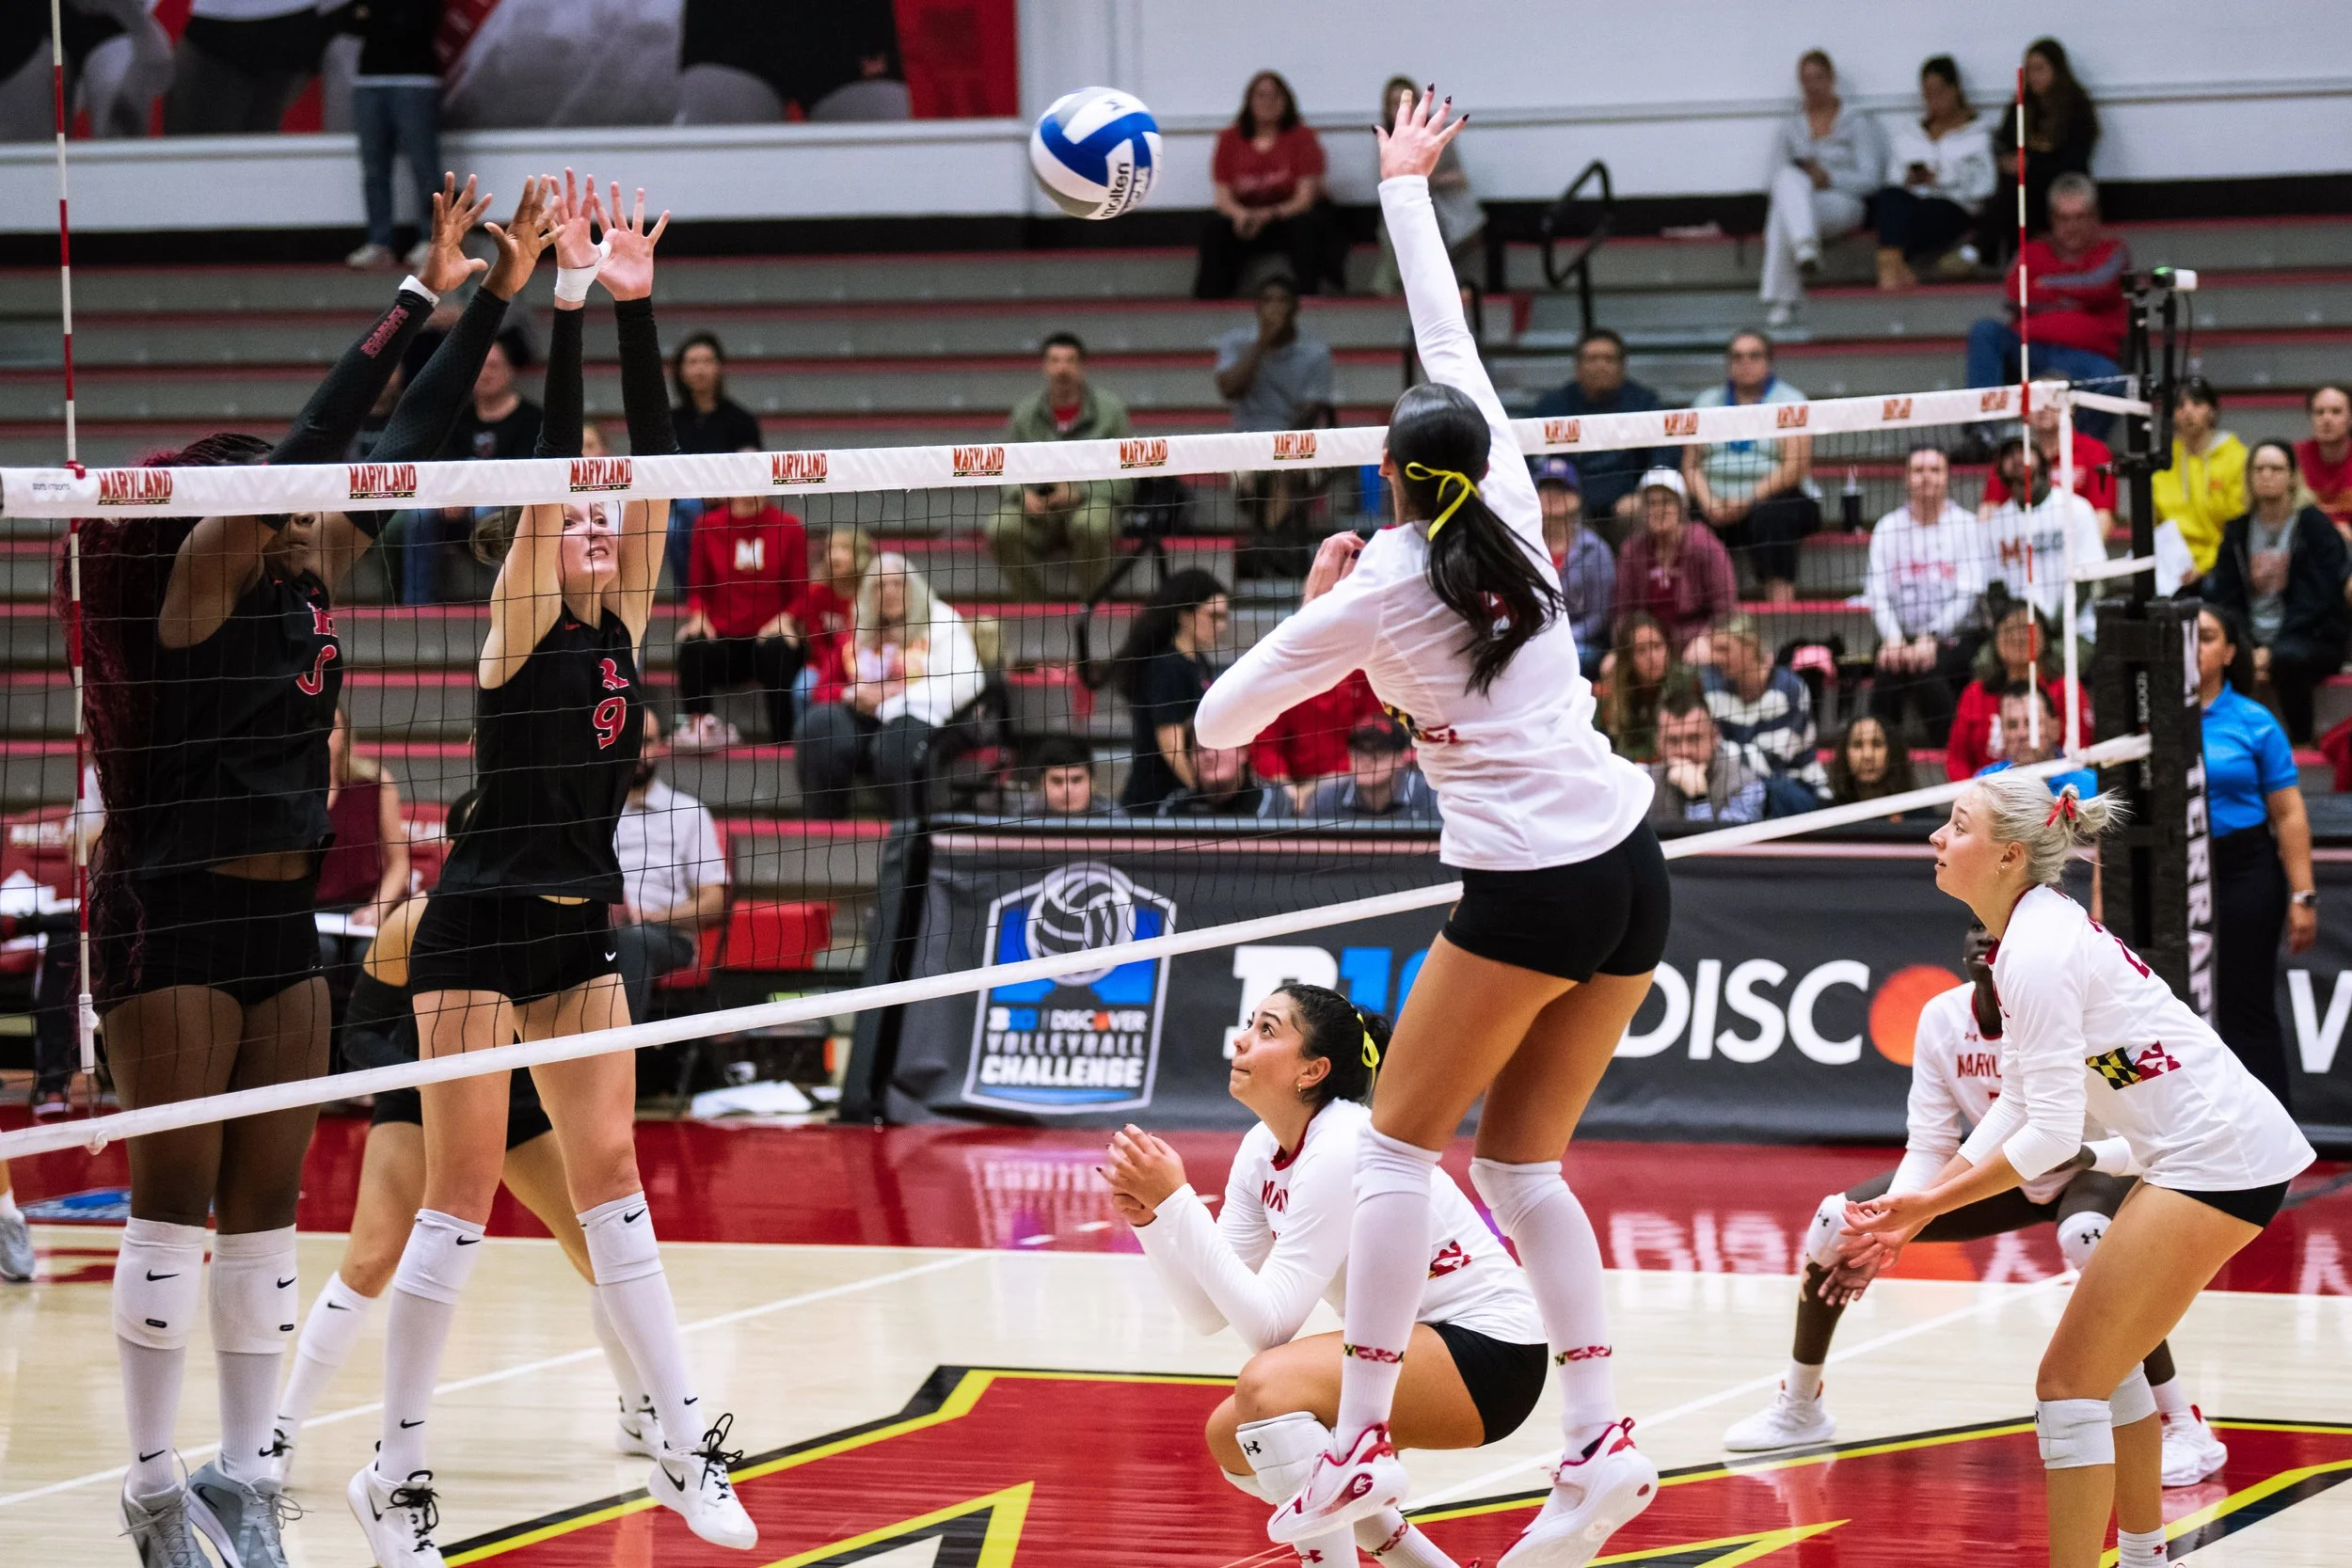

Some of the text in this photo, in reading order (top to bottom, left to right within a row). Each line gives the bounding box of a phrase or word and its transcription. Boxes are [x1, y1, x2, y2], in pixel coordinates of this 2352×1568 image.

[1101, 162, 1131, 218] molten
[952, 446, 1006, 471] MARYLAND
[1120, 438, 1168, 463] MARYLAND
[348, 464, 418, 492] MARYLAND
[569, 458, 633, 485] MARYLAND
[771, 452, 829, 479] MARYLAND
[97, 469, 174, 499] MARYLAND
[734, 536, 765, 572] M
[592, 696, 627, 751] 9
[987, 1032, 1144, 1056] VOLLEYBALL
[980, 1054, 1144, 1087] CHALLENGE
